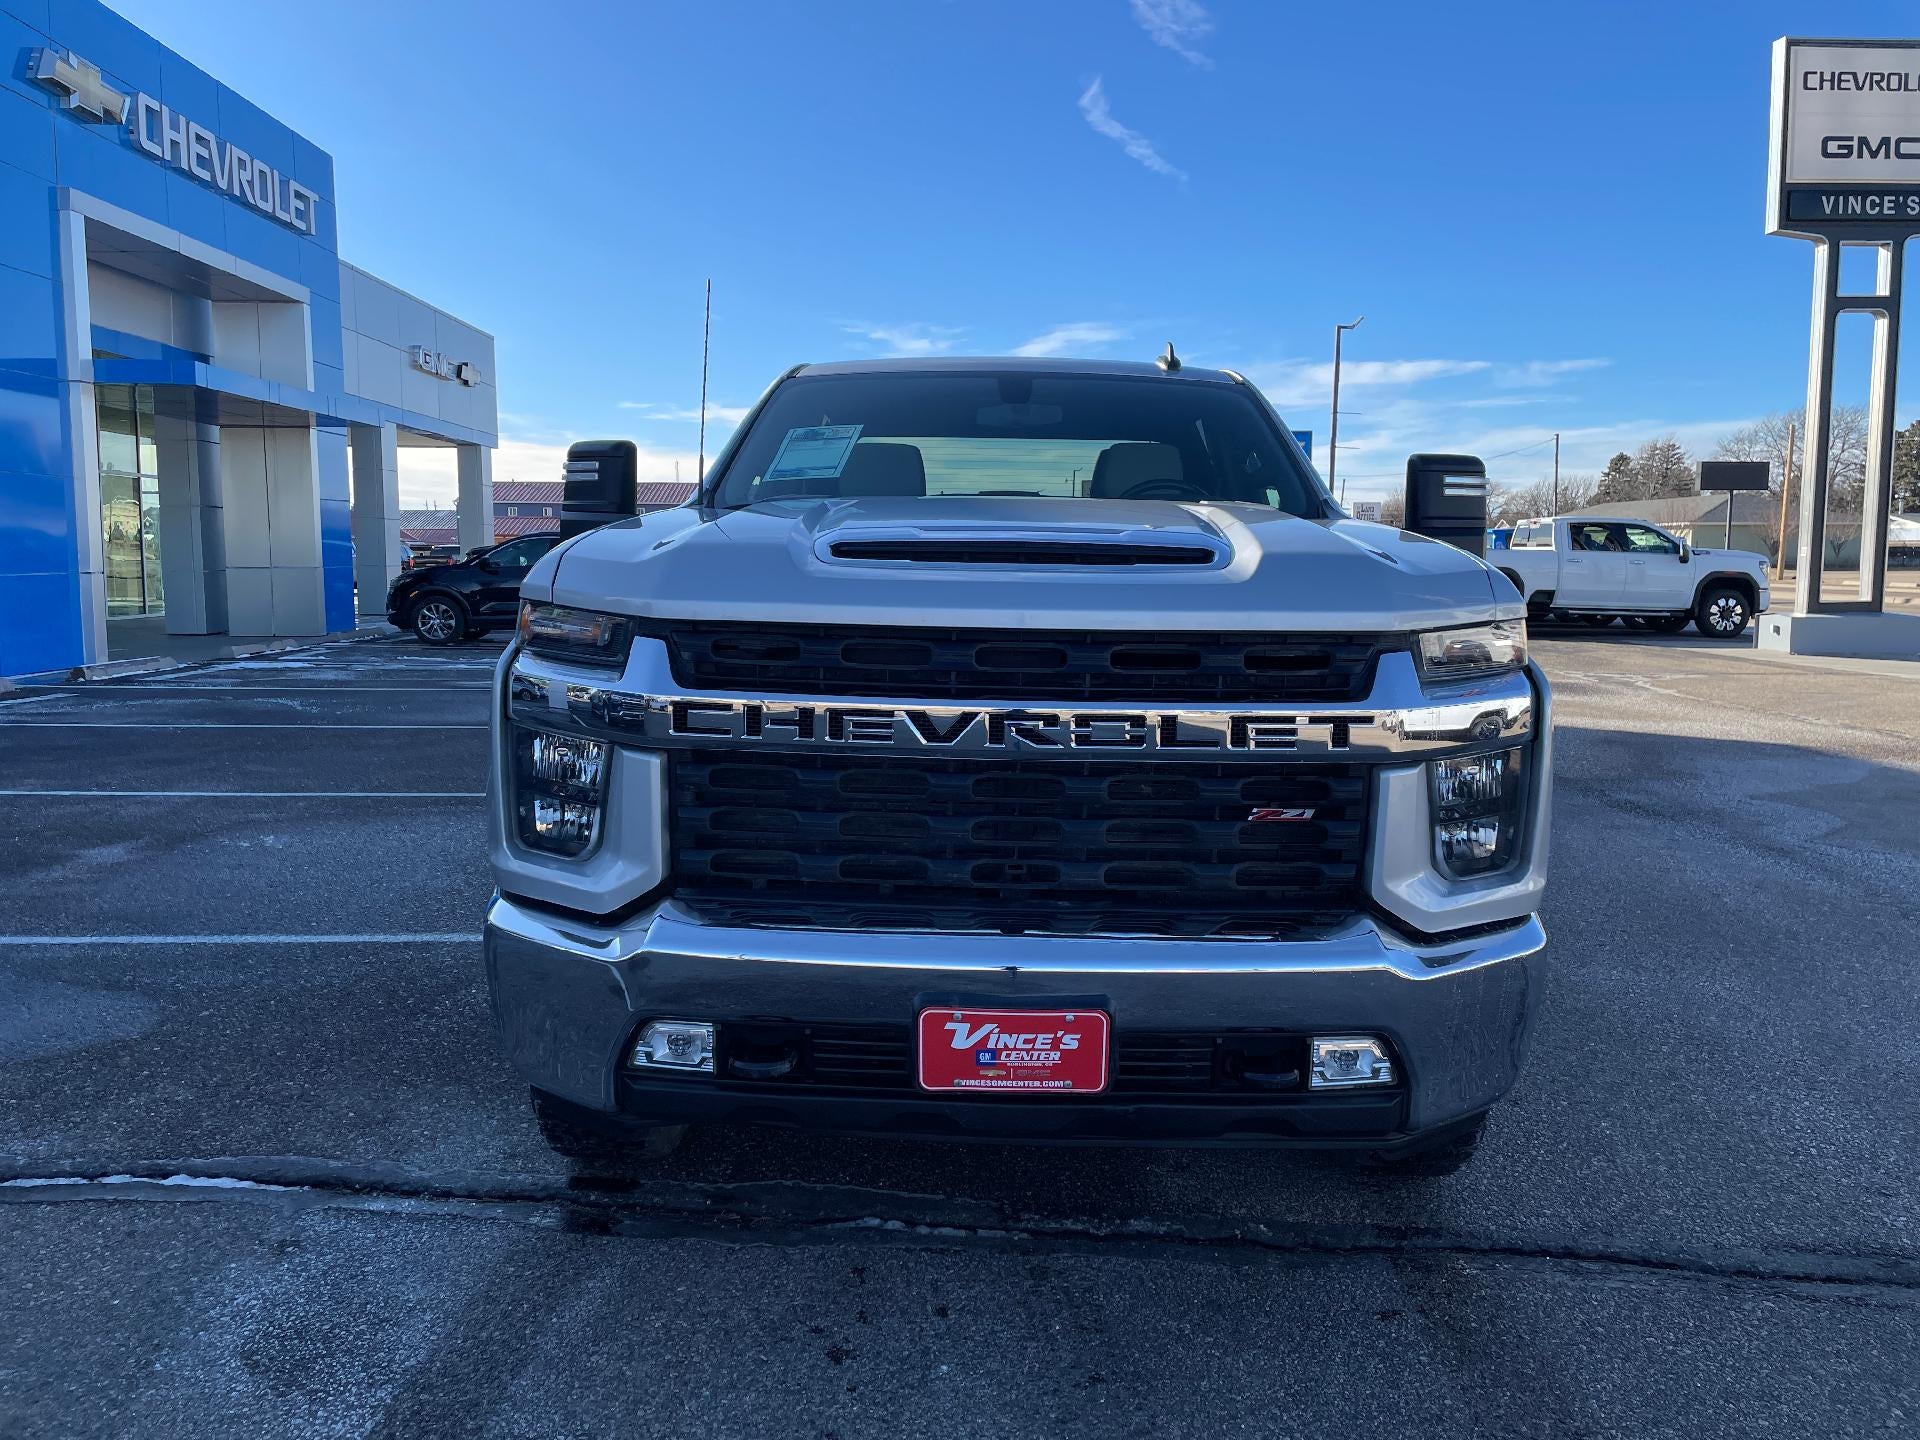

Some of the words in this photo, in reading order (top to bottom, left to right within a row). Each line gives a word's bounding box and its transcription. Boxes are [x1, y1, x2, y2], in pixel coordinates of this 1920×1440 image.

[1803, 71, 1920, 92] CHEVROL
[1820, 136, 1920, 160] GMC
[136, 91, 319, 236] CHEVROLET
[1821, 195, 1920, 216] VINCE'S
[669, 701, 1376, 752] CHEVROLET
[1247, 807, 1316, 822] Z71
[979, 1052, 992, 1061] GM
[1000, 1051, 1061, 1061] CENTER
[961, 1079, 1065, 1088] VINCESGMCENTER.COM
